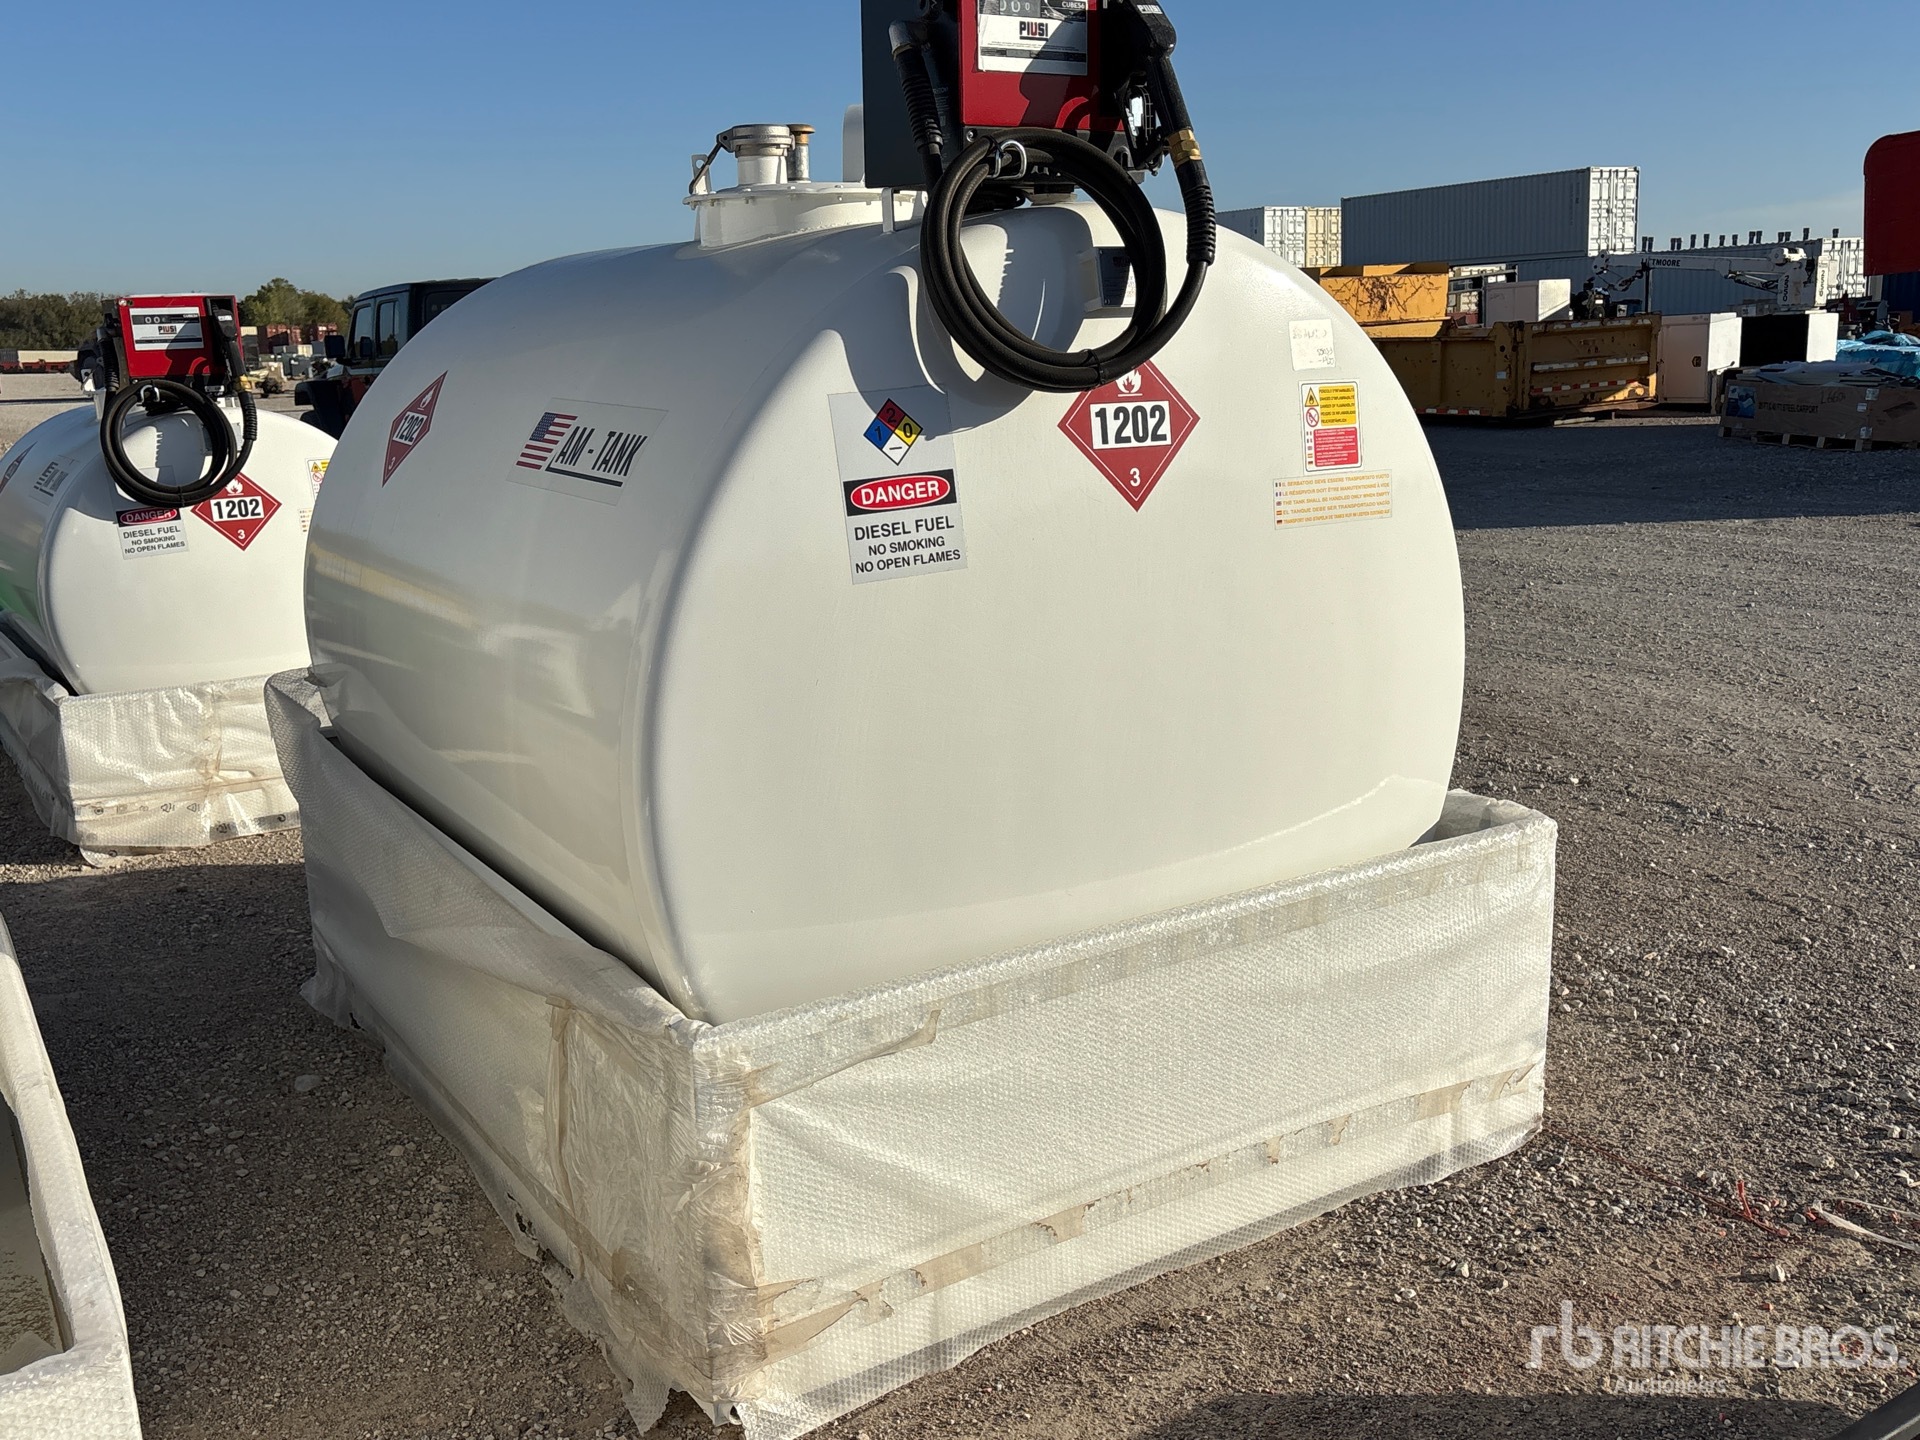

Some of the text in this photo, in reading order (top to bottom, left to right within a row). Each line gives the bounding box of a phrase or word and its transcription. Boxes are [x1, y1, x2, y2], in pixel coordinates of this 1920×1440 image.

[1061, 1, 1085, 9] CUBE56
[1019, 20, 1048, 37] PIUSI
[158, 325, 177, 334] PIUSI
[886, 407, 897, 423] 2
[396, 414, 424, 442] 1202
[874, 422, 913, 442] 1 0
[1094, 404, 1168, 445] 1202
[1129, 467, 1141, 487] 3
[860, 480, 940, 506] DANGER
[126, 509, 173, 524] DANGER
[213, 498, 262, 520] 1202
[122, 525, 181, 540] DIESEL FUEL
[237, 529, 246, 540] 3
[854, 515, 954, 541] DIESEL FUEL
[136, 544, 156, 553] OPEN
[157, 541, 186, 550] FLAMES
[143, 534, 176, 546] SMOKING
[868, 536, 946, 556] NO SMOKING
[855, 550, 960, 574] NO OPEN FLAMES
